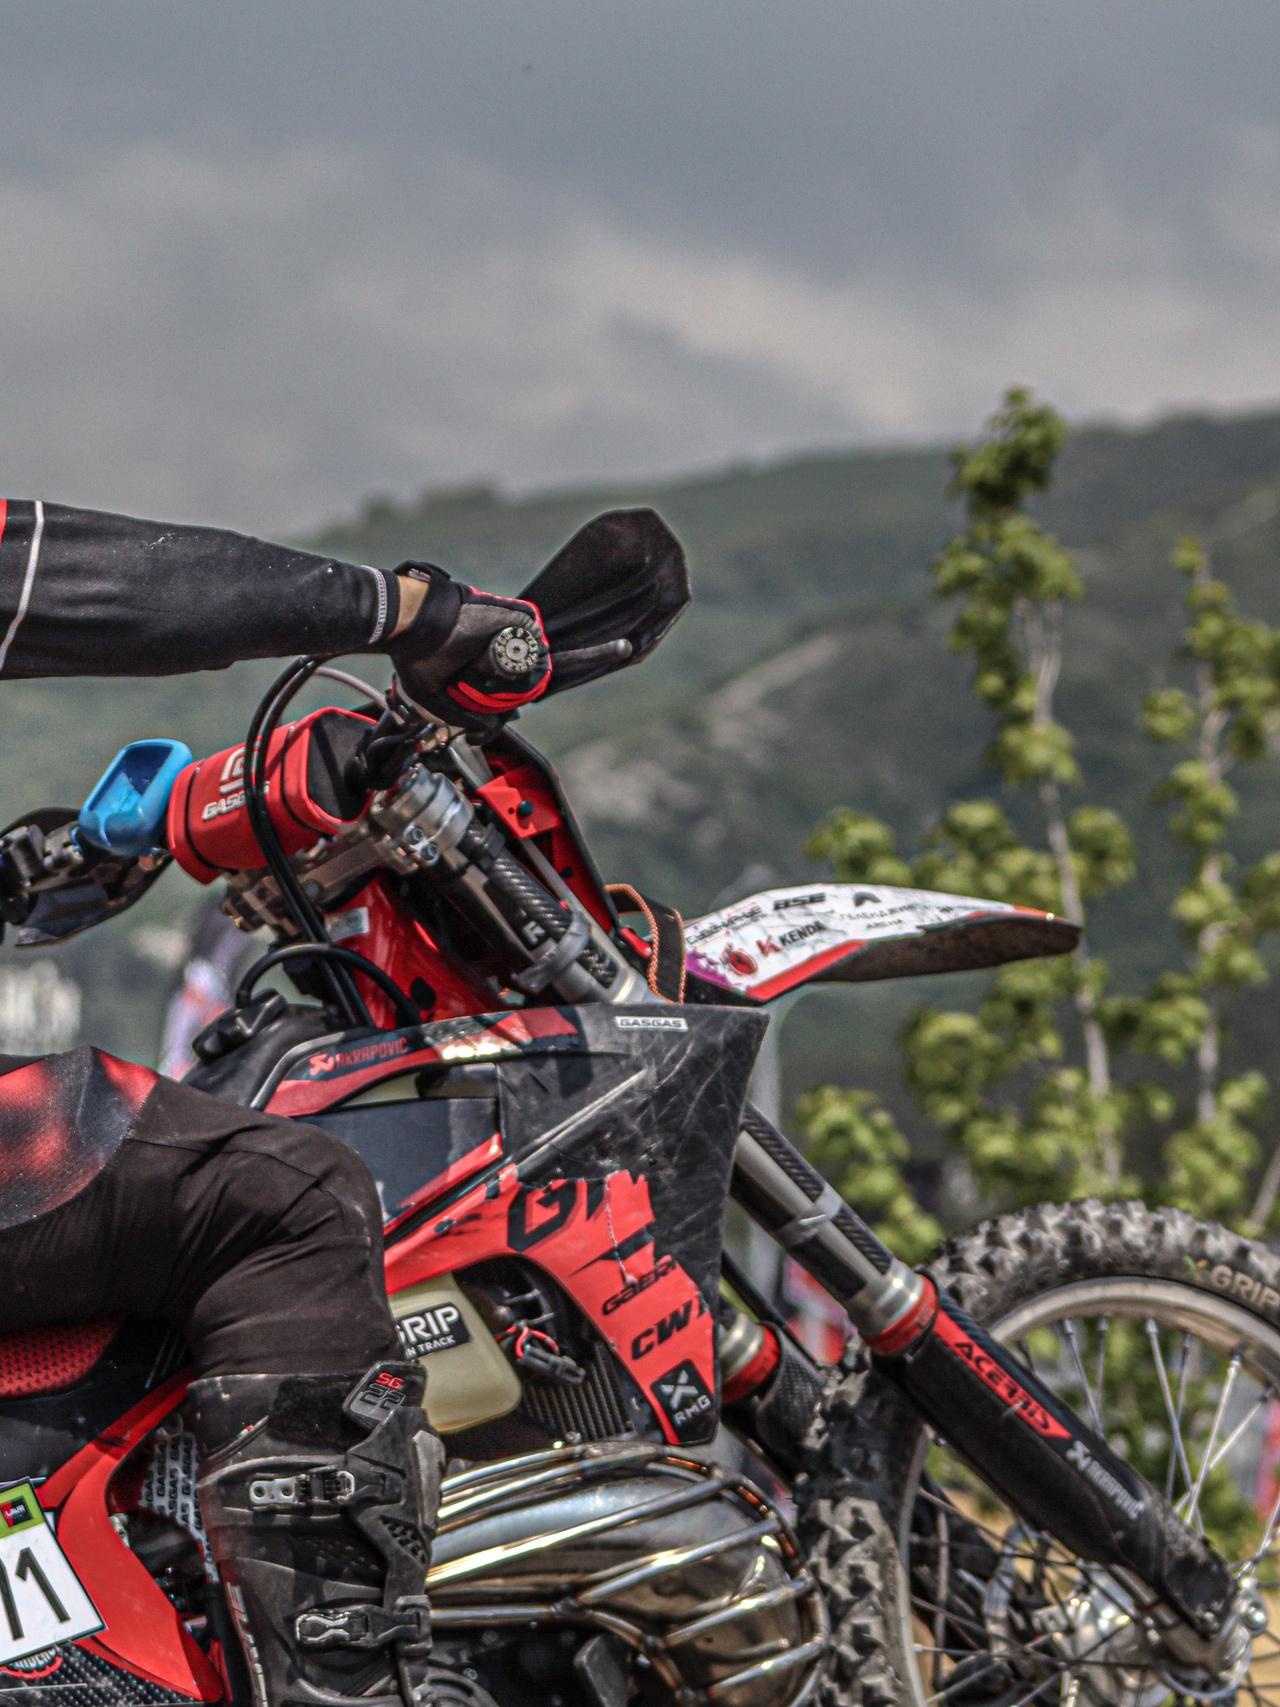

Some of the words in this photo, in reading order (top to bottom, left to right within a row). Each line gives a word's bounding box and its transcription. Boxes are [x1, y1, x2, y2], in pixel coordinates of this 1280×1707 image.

[778, 919, 827, 946] KENDA
[620, 1018, 682, 1028] GASGAS
[418, 1334, 456, 1353] TRACK
[673, 1394, 712, 1425] RMG
